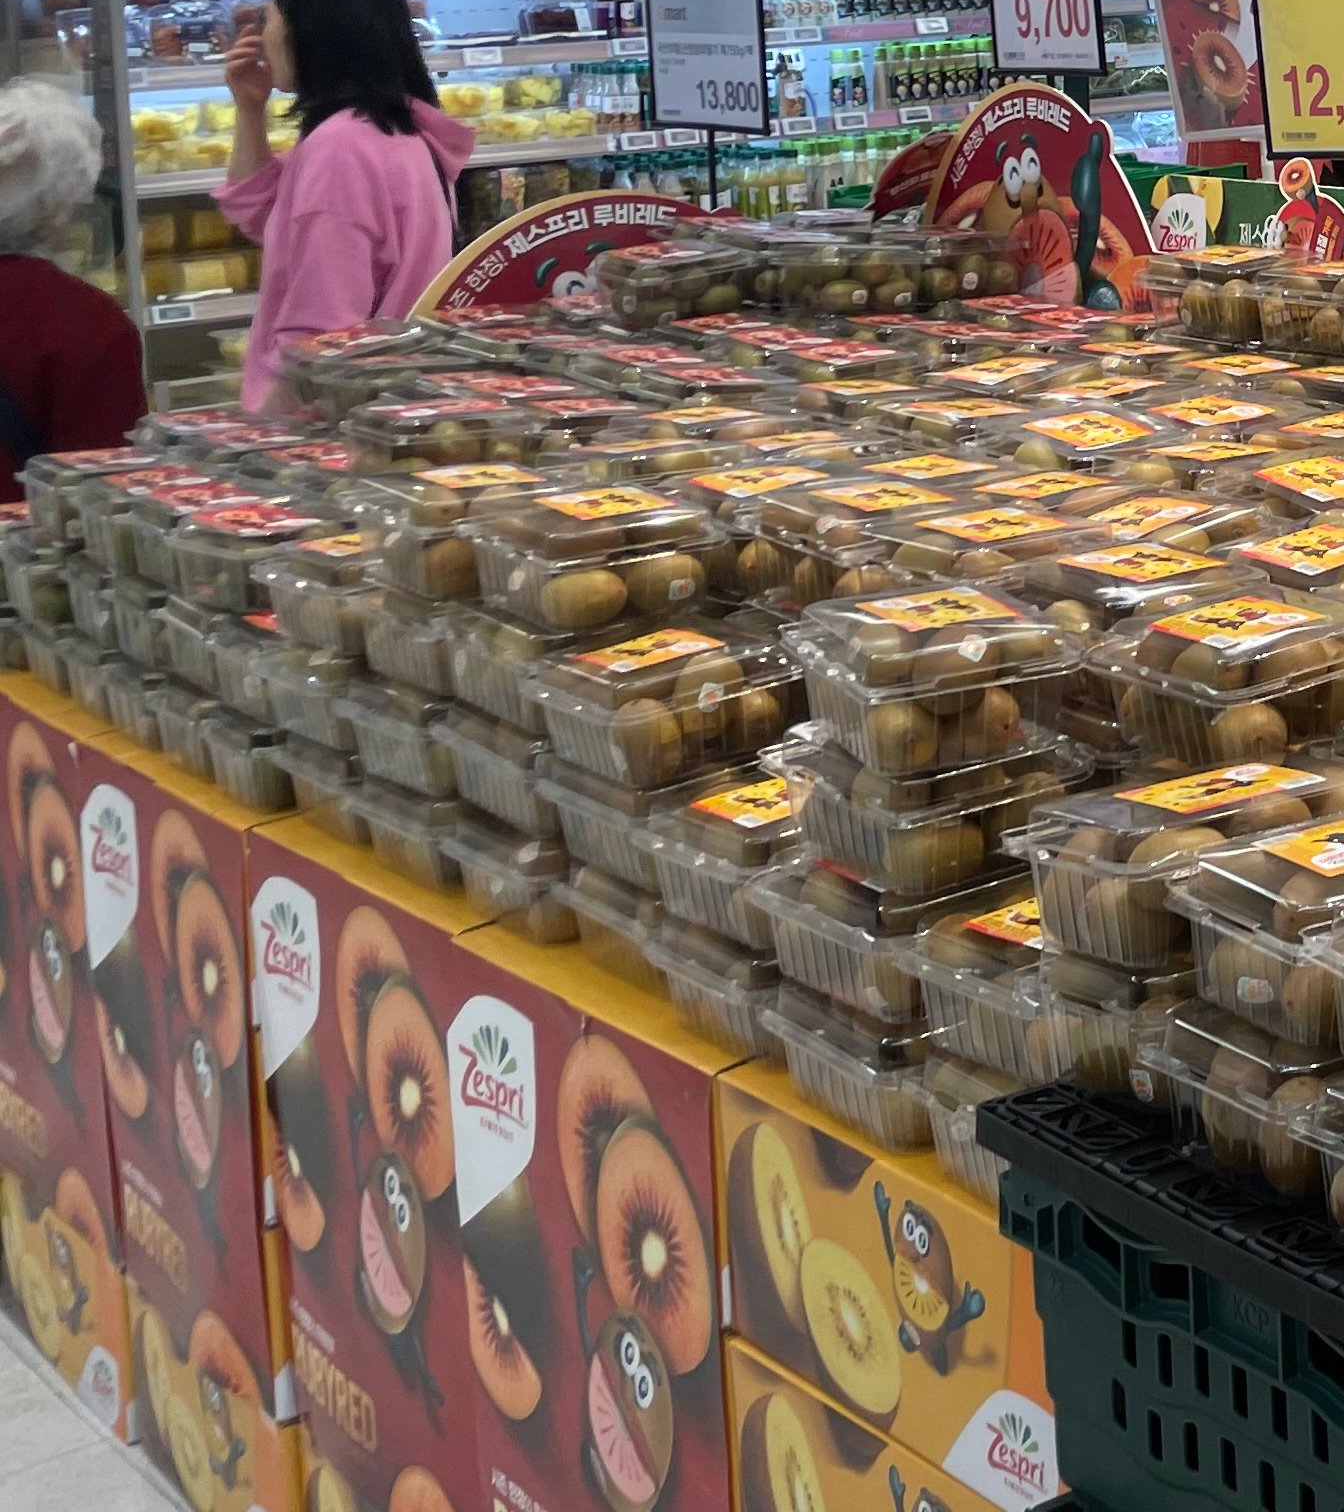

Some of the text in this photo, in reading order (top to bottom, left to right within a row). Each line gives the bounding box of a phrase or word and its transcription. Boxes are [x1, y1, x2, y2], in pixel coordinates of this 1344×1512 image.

[696, 79, 759, 112] 13,800
[982, 97, 1024, 136] 제스프리
[1026, 97, 1071, 133] 루비레드
[464, 203, 676, 293] 한정! 제스프리 루비레드
[1159, 224, 1198, 251] Zespri
[261, 920, 313, 991] Zespri
[459, 1045, 528, 1128] Zespri
[988, 1427, 1048, 1489] Zespri
